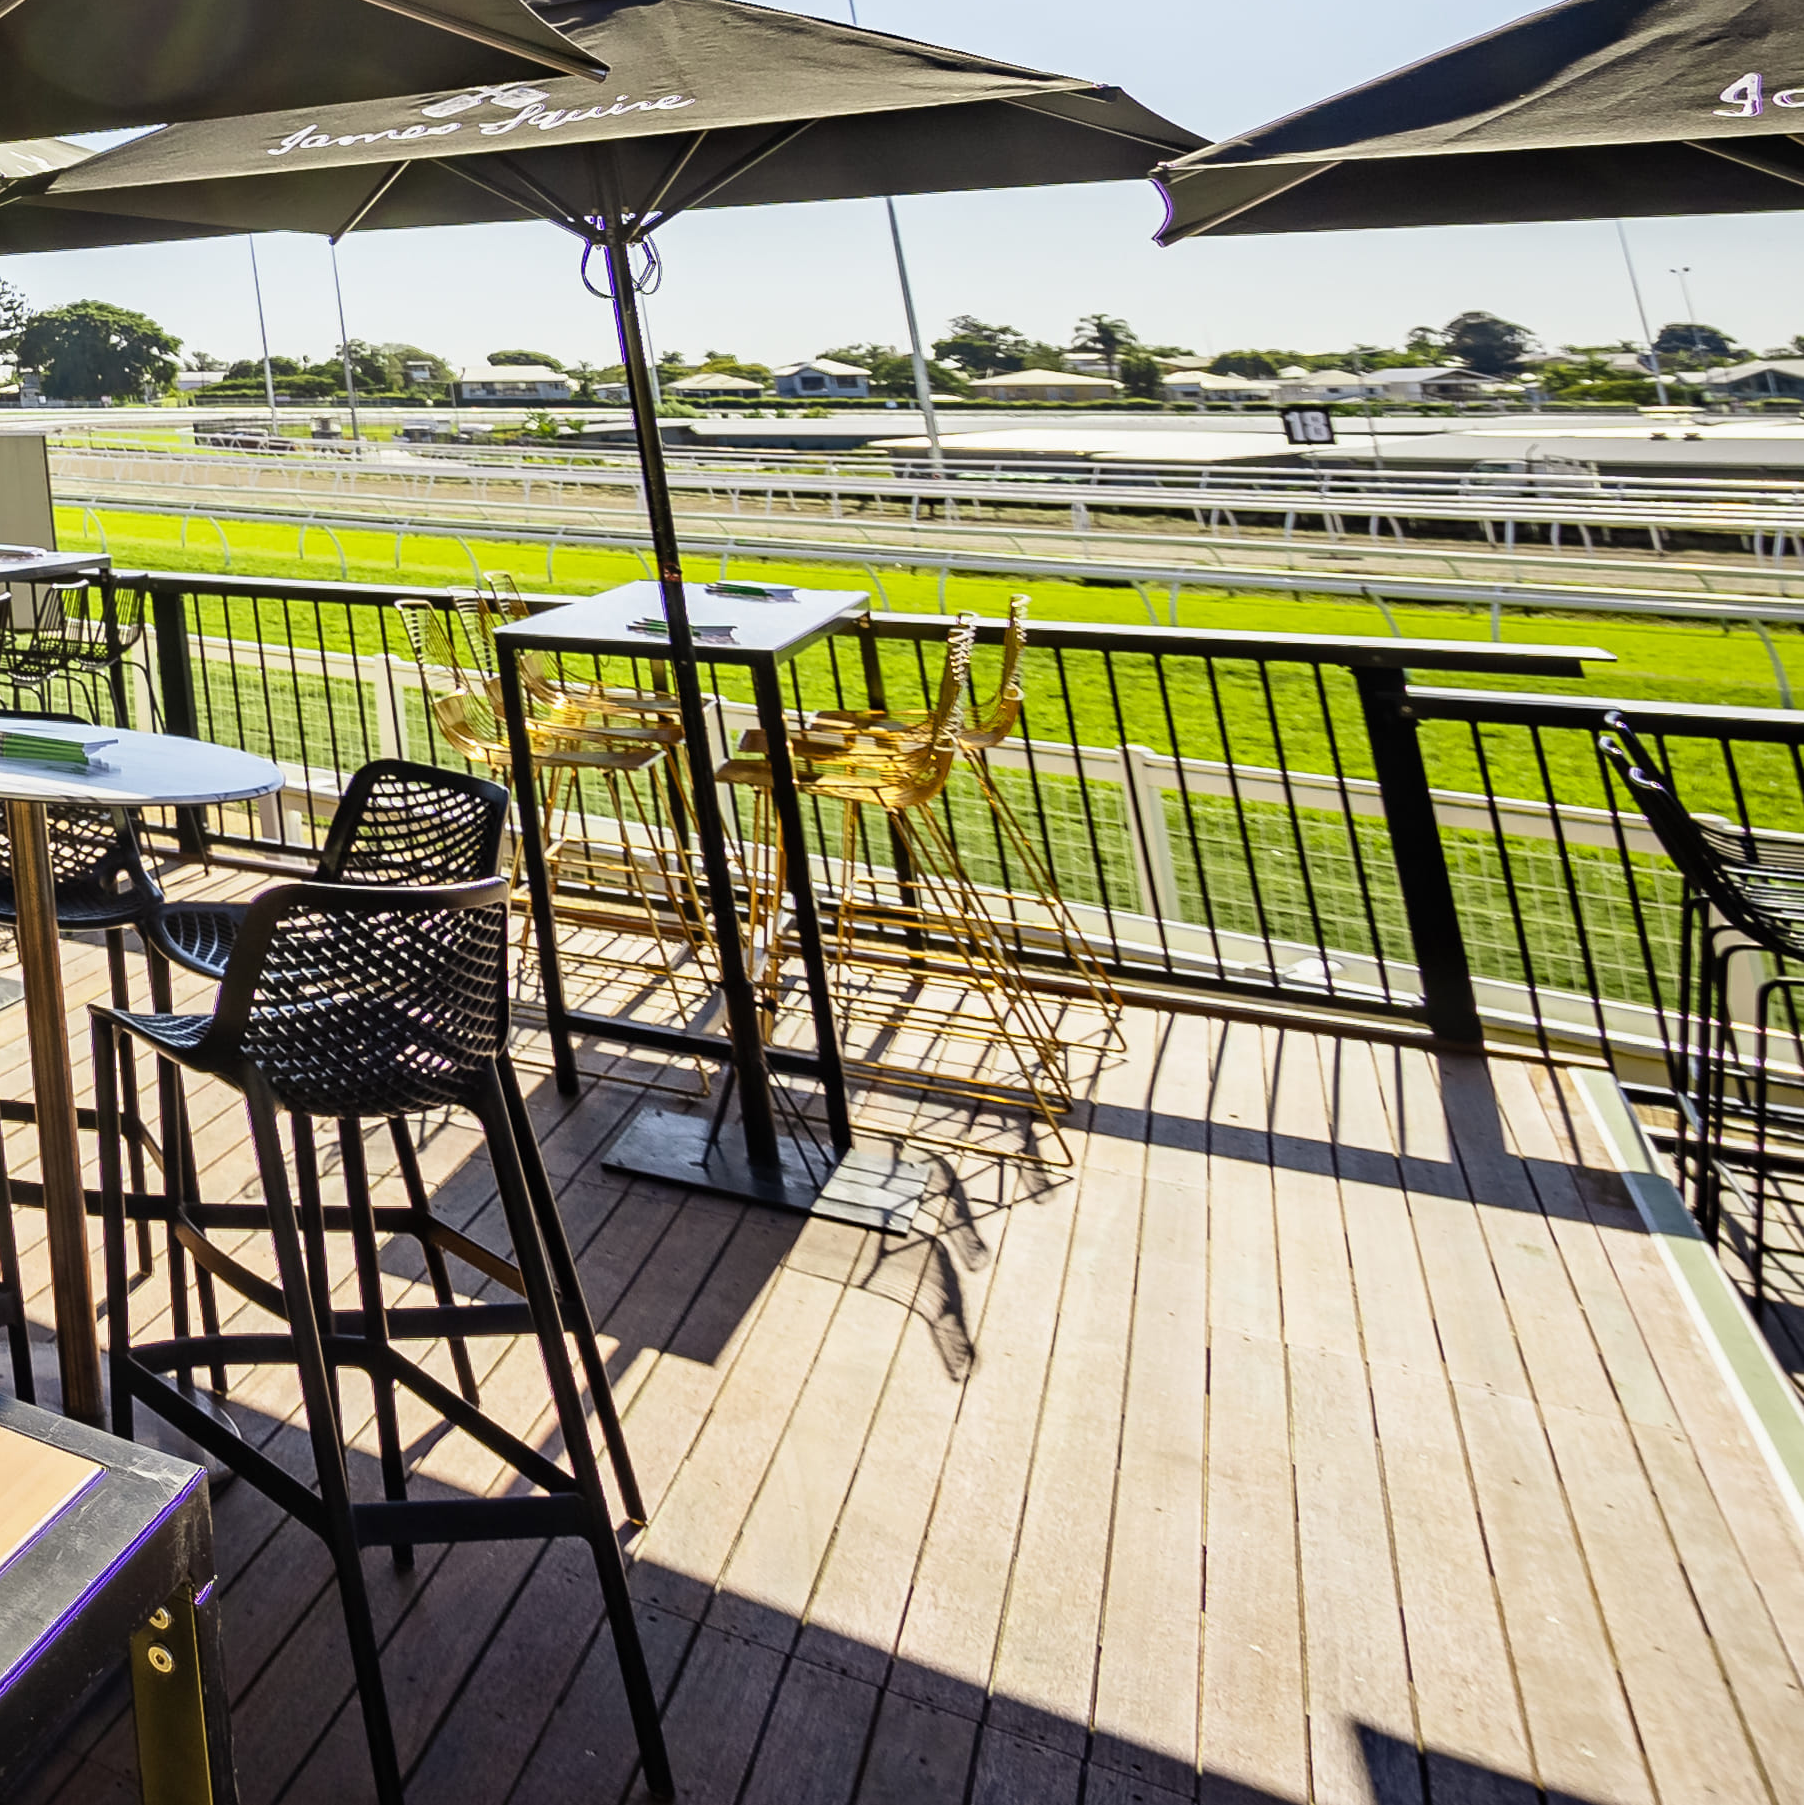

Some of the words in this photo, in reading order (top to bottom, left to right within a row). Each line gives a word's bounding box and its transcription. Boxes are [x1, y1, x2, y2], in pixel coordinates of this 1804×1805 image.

[267, 123, 463, 156] James
[477, 94, 696, 136] Squire
[1285, 411, 1331, 442] 18
